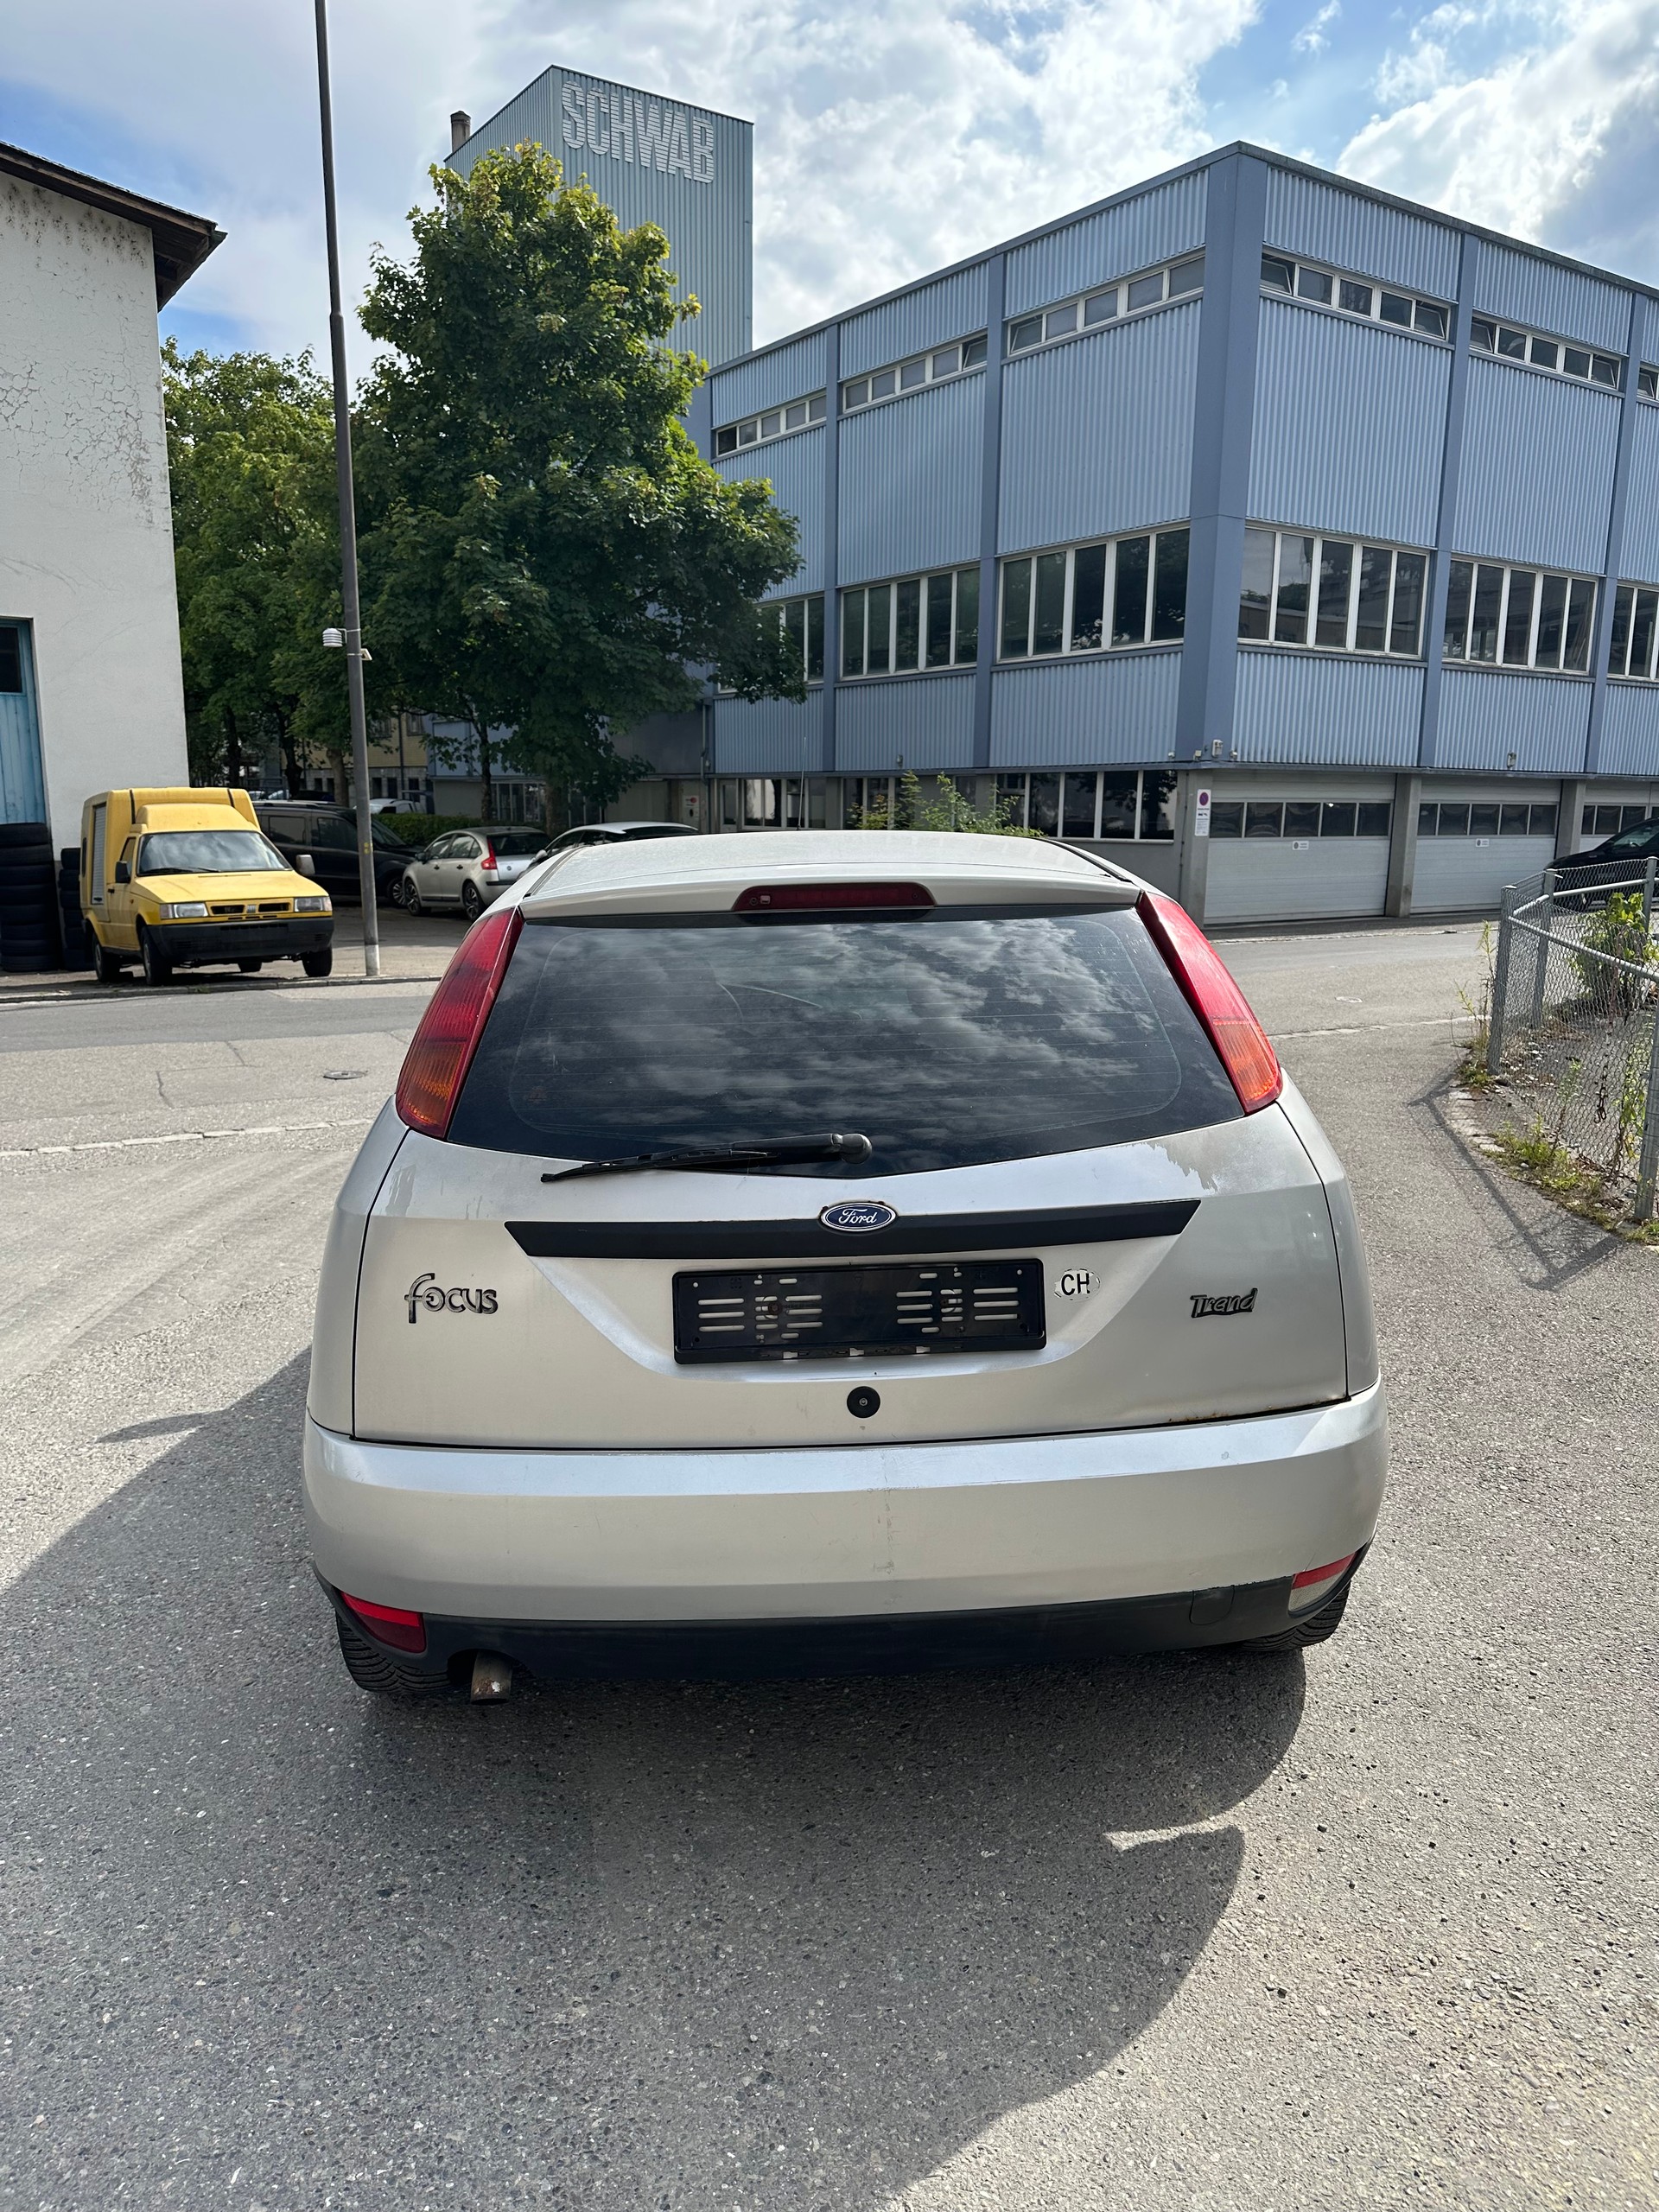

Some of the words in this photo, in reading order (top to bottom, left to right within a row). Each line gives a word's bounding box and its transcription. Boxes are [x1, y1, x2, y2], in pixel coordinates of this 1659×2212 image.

[562, 80, 715, 183] SCHWAB
[838, 1208, 877, 1224] Ford
[1060, 1273, 1090, 1296] CH
[1190, 1287, 1258, 1319] Trend
